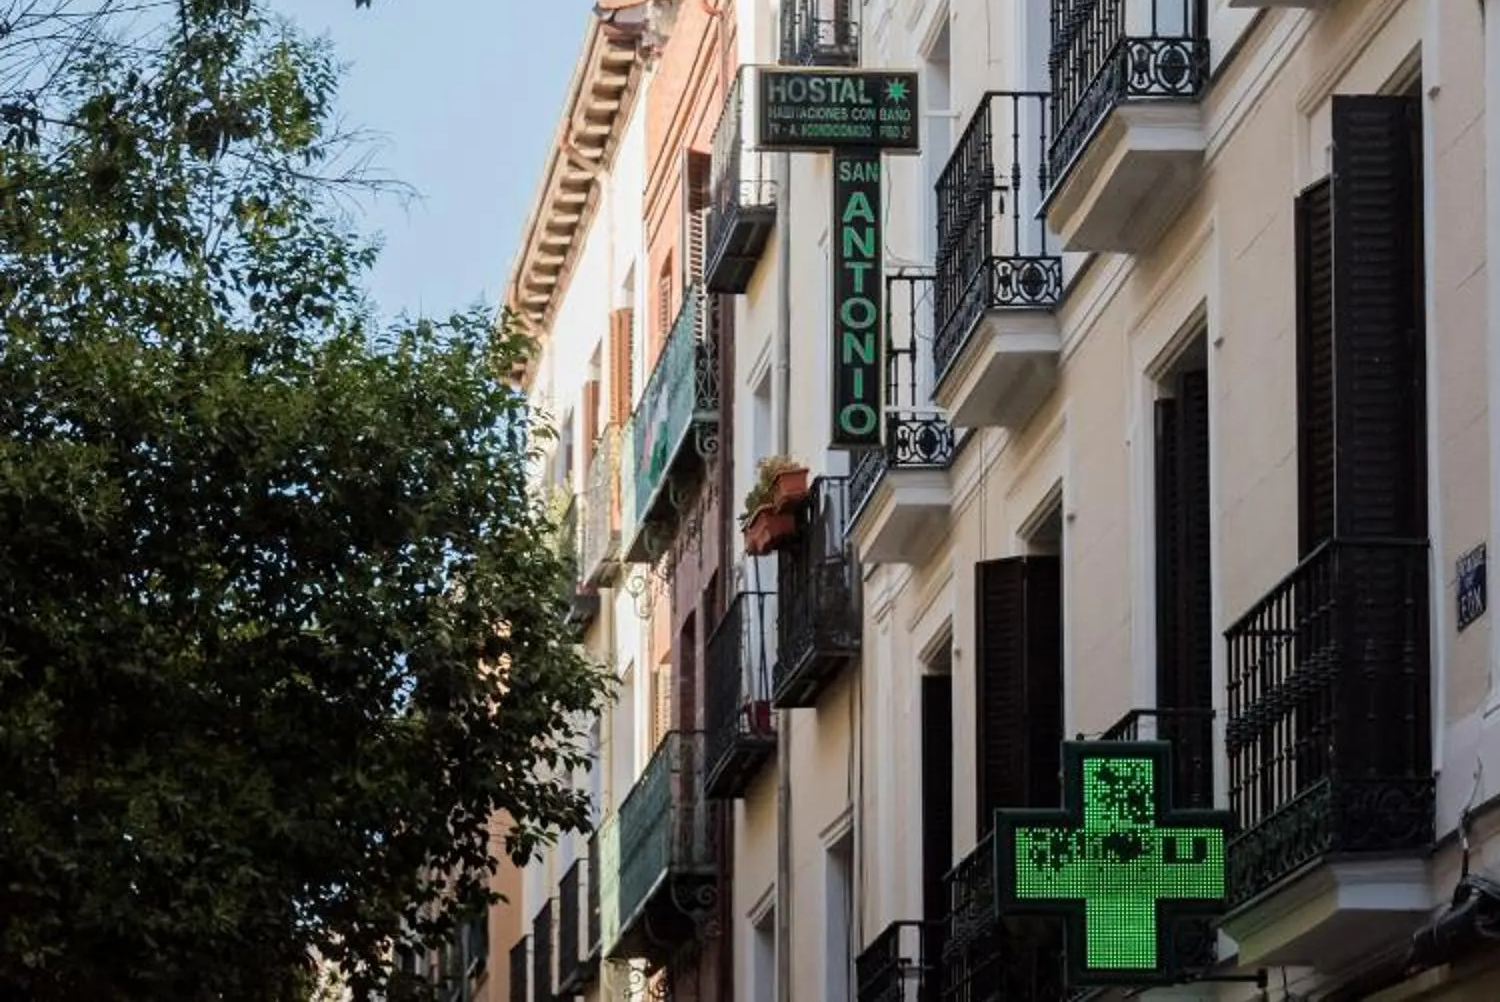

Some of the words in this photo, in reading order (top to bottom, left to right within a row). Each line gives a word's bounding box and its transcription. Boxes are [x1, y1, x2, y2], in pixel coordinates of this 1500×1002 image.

[767, 76, 873, 104] HOSTAL
[851, 107, 876, 121] CON
[839, 161, 879, 183] SAN
[840, 191, 877, 436] ANTONIO
